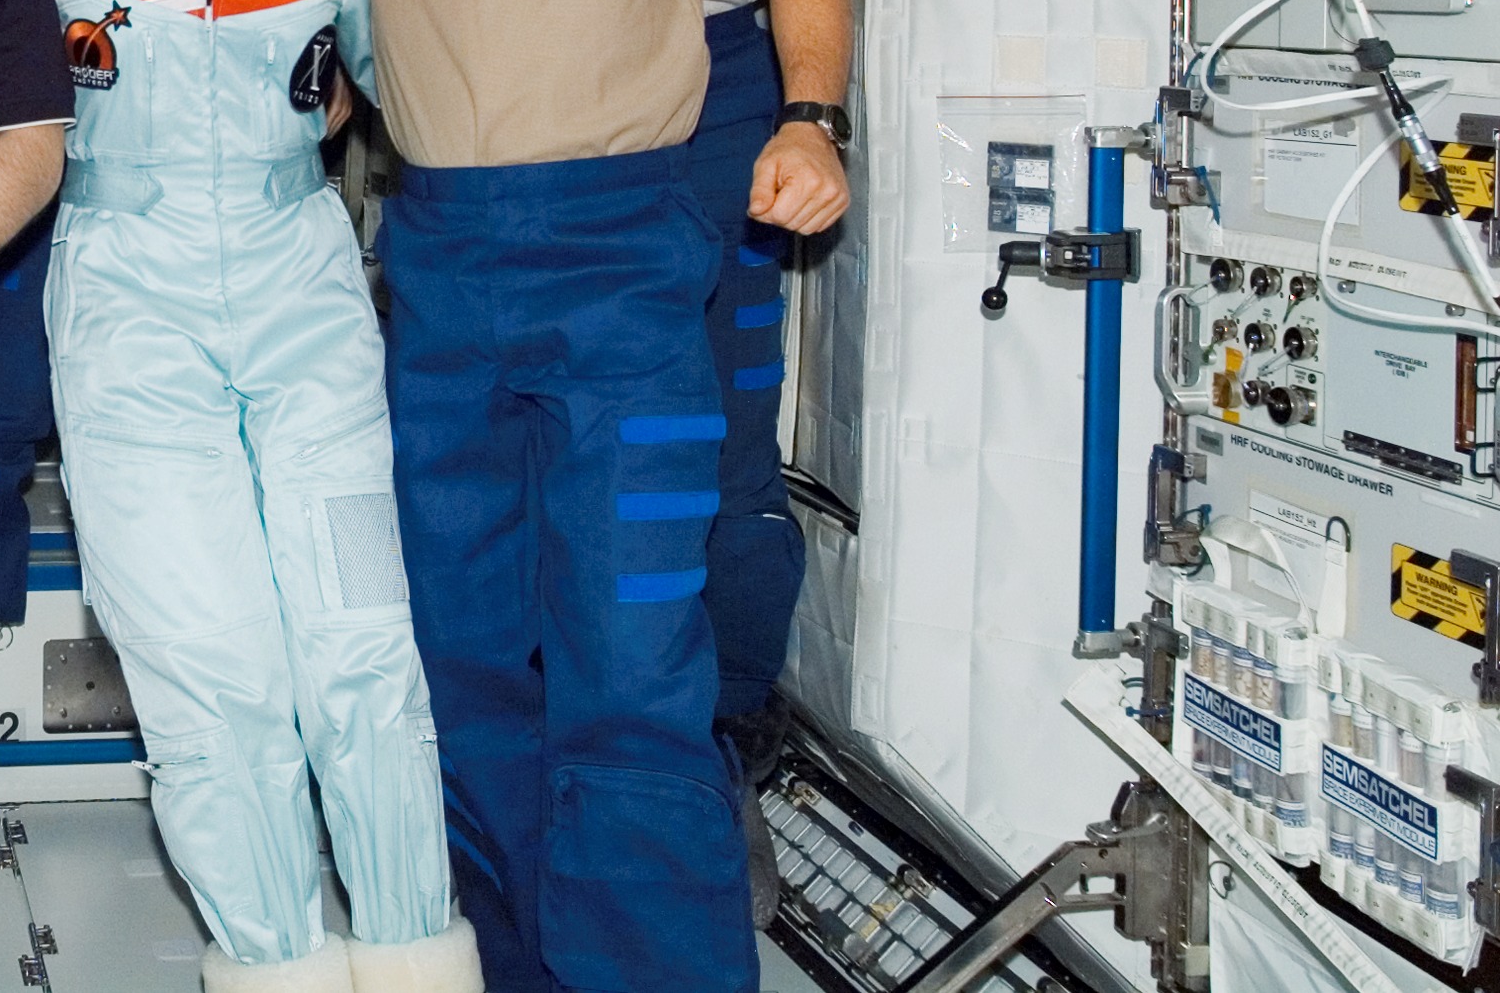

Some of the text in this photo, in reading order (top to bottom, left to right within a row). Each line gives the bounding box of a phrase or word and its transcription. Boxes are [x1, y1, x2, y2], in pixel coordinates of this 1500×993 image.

[1444, 163, 1467, 176] NING
[1230, 433, 1394, 497] HRF COOLING STOWAGE DRAWER
[1415, 571, 1459, 597] WARNING
[1185, 676, 1281, 748] SEMSATCHEL
[1322, 749, 1436, 834] SEMSATCHEL
